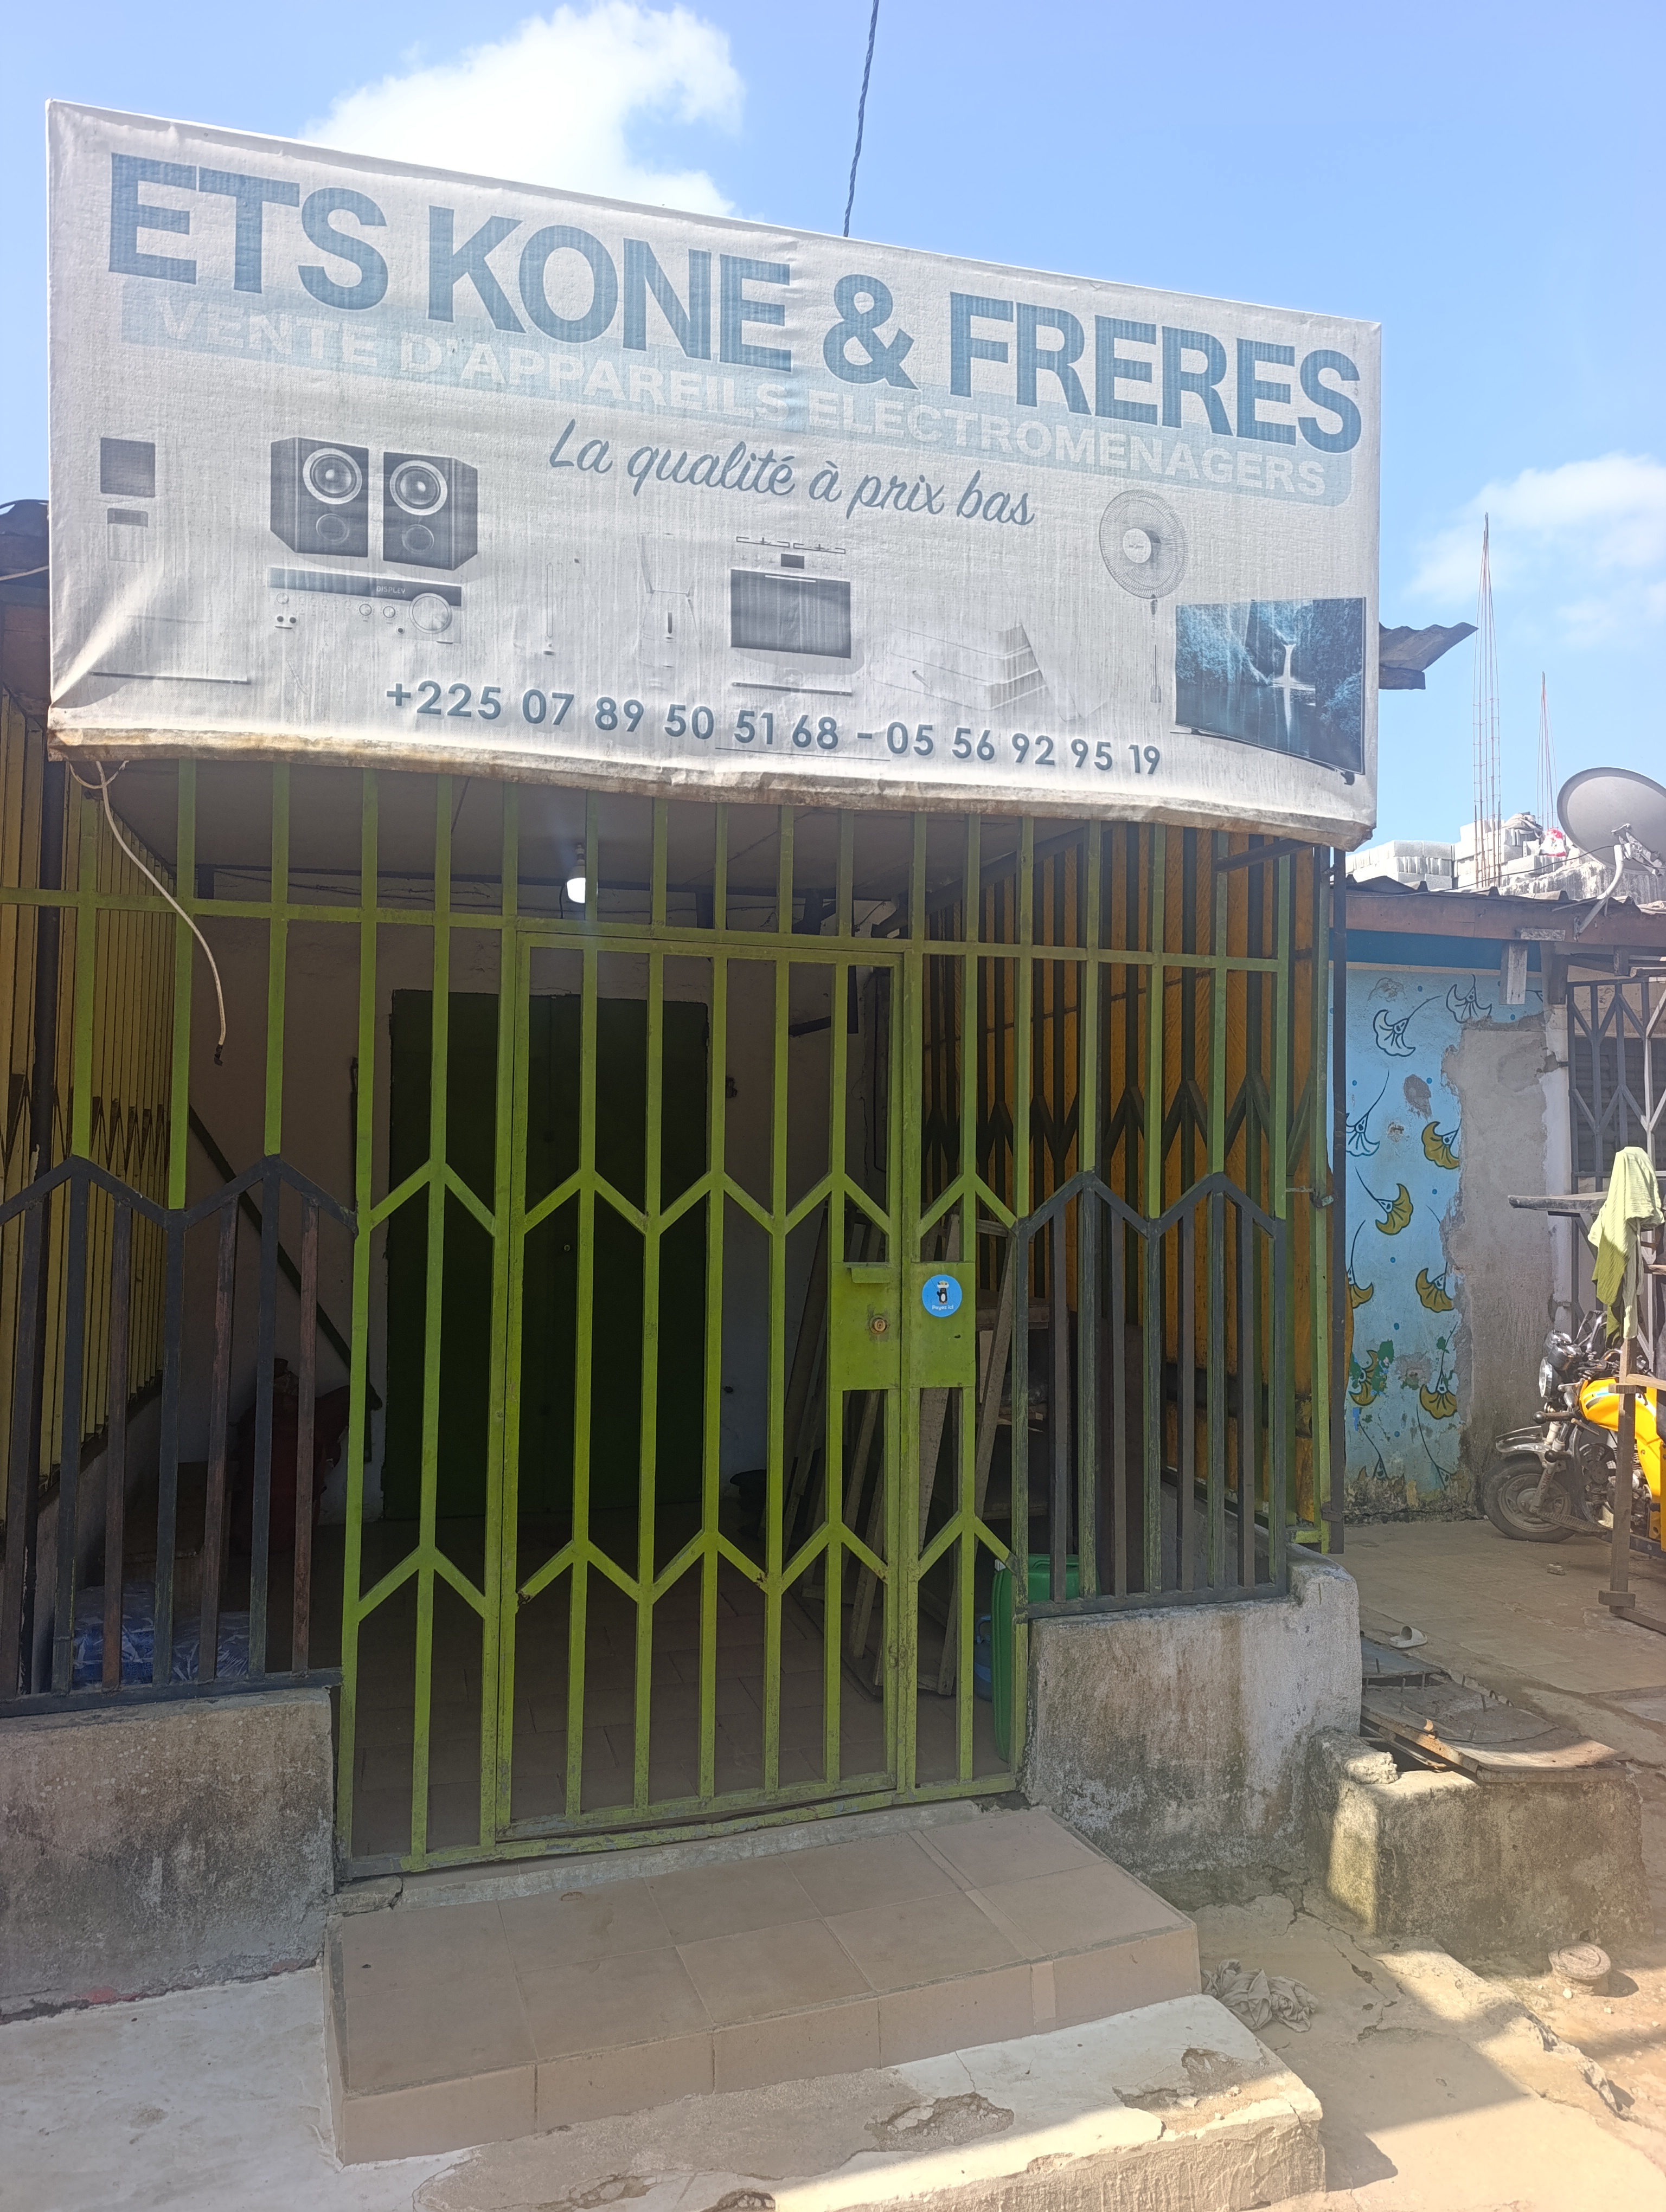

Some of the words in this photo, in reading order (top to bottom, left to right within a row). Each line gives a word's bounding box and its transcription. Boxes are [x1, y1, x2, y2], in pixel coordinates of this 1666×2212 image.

[108, 152, 389, 311] ETS
[428, 204, 792, 373] KONE
[822, 274, 920, 391] &
[950, 291, 1362, 454] FRERES
[155, 297, 379, 369] VENTE
[399, 331, 792, 422] D'APPAREILS
[808, 388, 1325, 497] ELECTROMENAGERS
[549, 418, 613, 474] La
[626, 441, 796, 497] qualité
[808, 460, 843, 503] à
[845, 474, 945, 520] prix
[956, 470, 1035, 525] bas
[386, 679, 502, 720] +225
[522, 689, 575, 725] 07
[594, 697, 644, 732] 89
[664, 704, 714, 740] 50
[734, 710, 773, 745] 51
[792, 715, 839, 750] 68
[887, 722, 934, 756] 05
[952, 727, 995, 761] 56
[1011, 732, 1055, 766] 92
[1070, 738, 1113, 771] 95
[1128, 744, 1161, 775] 19
